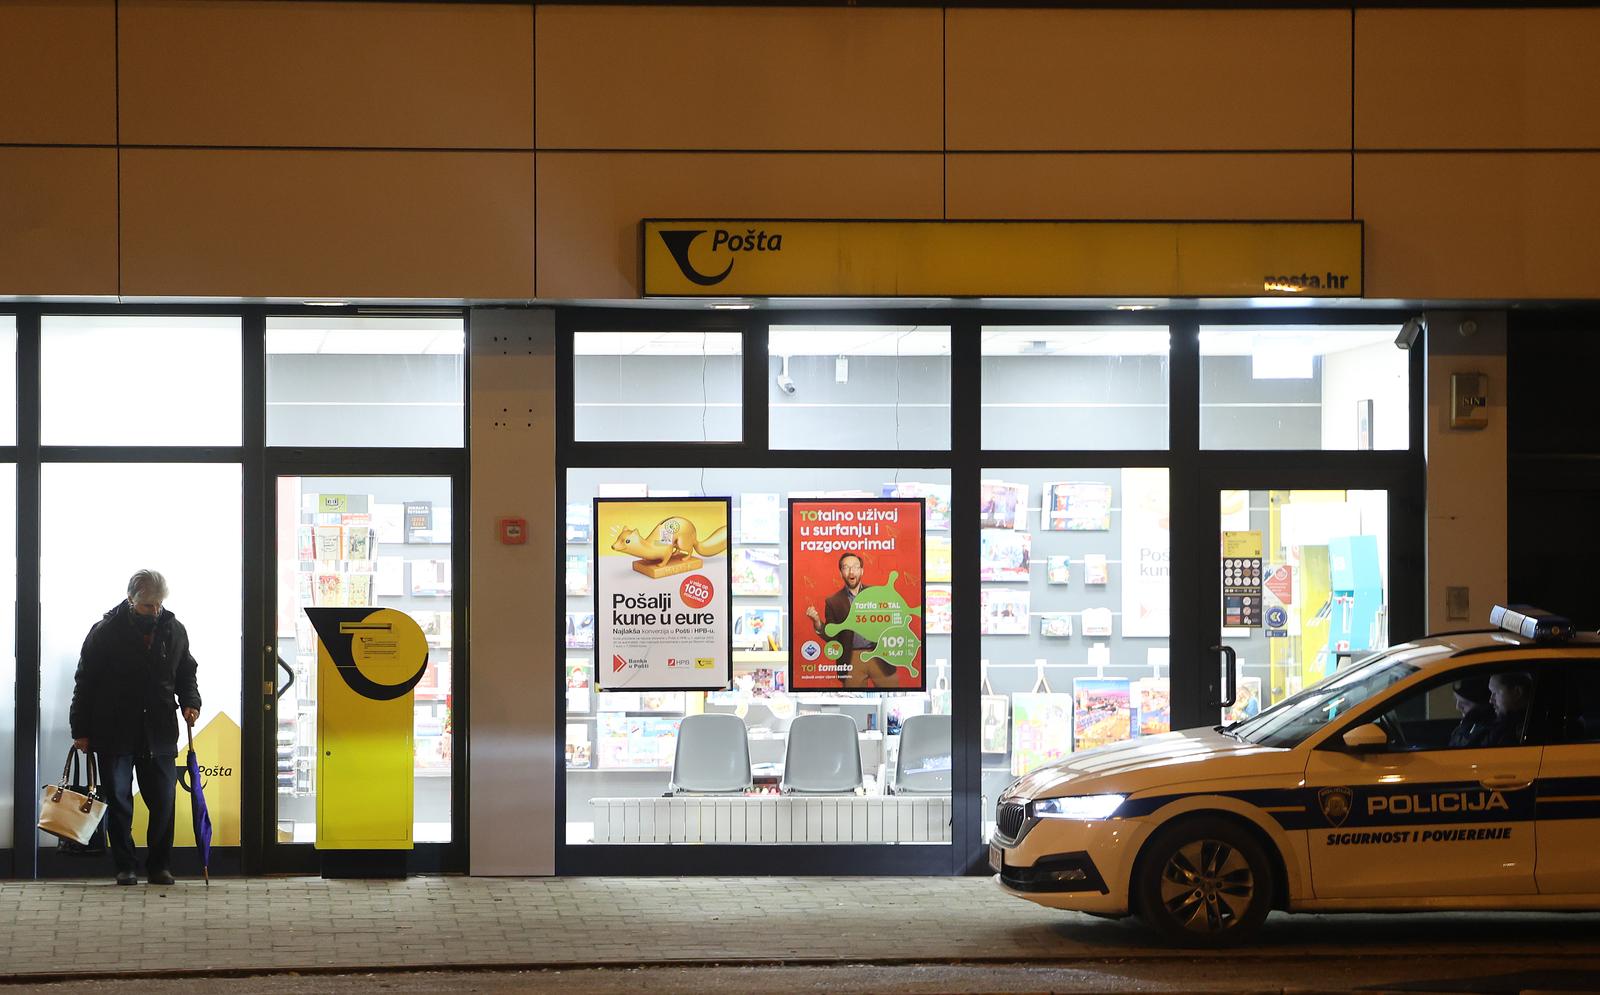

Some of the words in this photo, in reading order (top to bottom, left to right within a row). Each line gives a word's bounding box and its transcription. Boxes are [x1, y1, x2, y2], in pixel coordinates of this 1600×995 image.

[712, 229, 782, 251] Pošta
[800, 509, 854, 521] TOtalno
[857, 508, 898, 523] uživaj
[800, 526, 809, 536] u
[813, 523, 871, 537] surfanju
[875, 523, 879, 535] i
[800, 538, 895, 553] razgovorima!
[685, 584, 709, 599] 1000
[613, 592, 671, 612] Pošalji
[613, 610, 656, 625] kune
[660, 613, 671, 625] u
[675, 613, 714, 625] eure
[855, 615, 867, 623] 36
[870, 615, 890, 623] 000
[613, 628, 640, 636] Najlakša
[882, 636, 904, 648] 109
[818, 664, 853, 672] tomato
[198, 765, 232, 776] Pošta
[1367, 790, 1509, 816] POLICIJA
[1326, 831, 1410, 846] SIGURNOST
[1412, 830, 1420, 843] I
[1422, 828, 1512, 842] POVJERENJE
